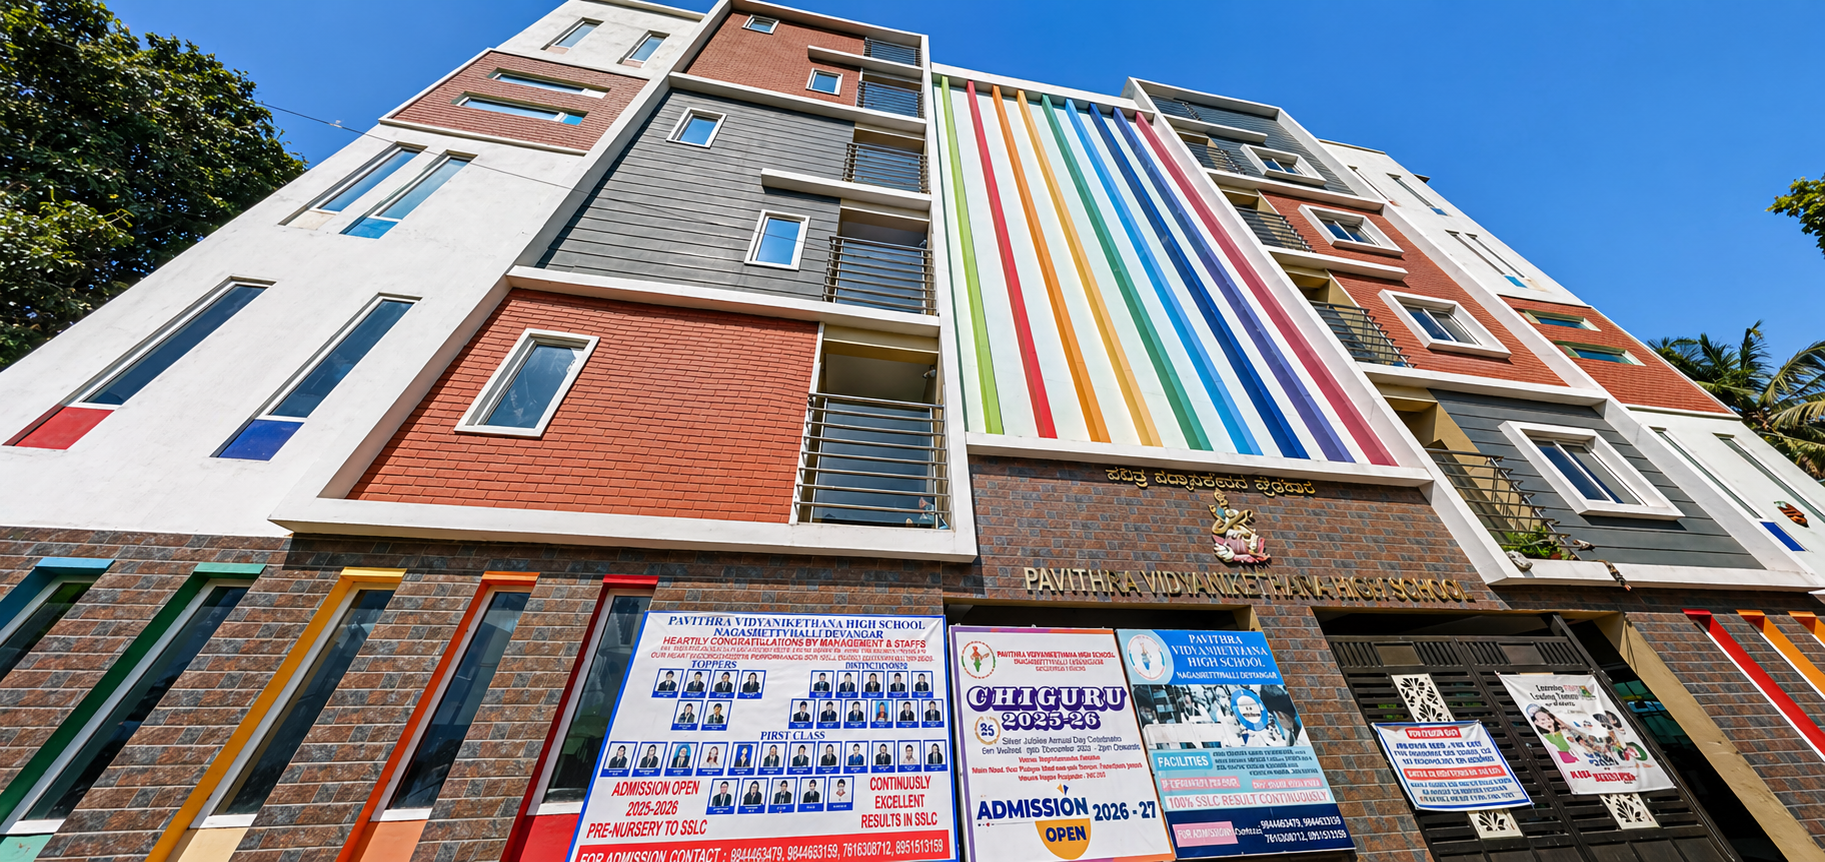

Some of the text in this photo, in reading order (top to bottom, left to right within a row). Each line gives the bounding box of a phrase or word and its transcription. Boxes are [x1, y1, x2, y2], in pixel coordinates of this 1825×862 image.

[1023, 567, 1142, 597] PAVITHRA
[1389, 577, 1477, 603] SCHOOL
[668, 616, 732, 627] PAVITHRA
[846, 619, 876, 630] HIGH
[878, 620, 926, 630] SCHOOL
[662, 636, 710, 646] HEARTILY
[805, 638, 819, 647] BY
[894, 639, 927, 648] STAFFS
[691, 660, 738, 669] TOPPERS
[1187, 656, 1266, 668] HIGH SCHOOL
[966, 686, 1127, 712] CHIGURU
[1001, 712, 1101, 731] 2025-26
[792, 731, 826, 740] CLASS
[1157, 756, 1210, 768] FACILITIES
[611, 780, 700, 797] ADMISSION OPEN
[625, 800, 679, 817] 2025-2026
[874, 794, 925, 809] EXCELLENT
[976, 797, 1089, 820] ADMISSION
[1169, 796, 1194, 809] 100%
[1195, 794, 1221, 808] SSLC
[1221, 792, 1258, 806] RESULT
[1092, 802, 1130, 821] 2026
[1139, 801, 1157, 818] 27
[586, 819, 708, 839] PRE-NURSERY TO SSLC
[861, 812, 938, 829] RESULTS IN SSLC
[1045, 825, 1087, 842] OPEN
[669, 848, 721, 862] CONTACT
